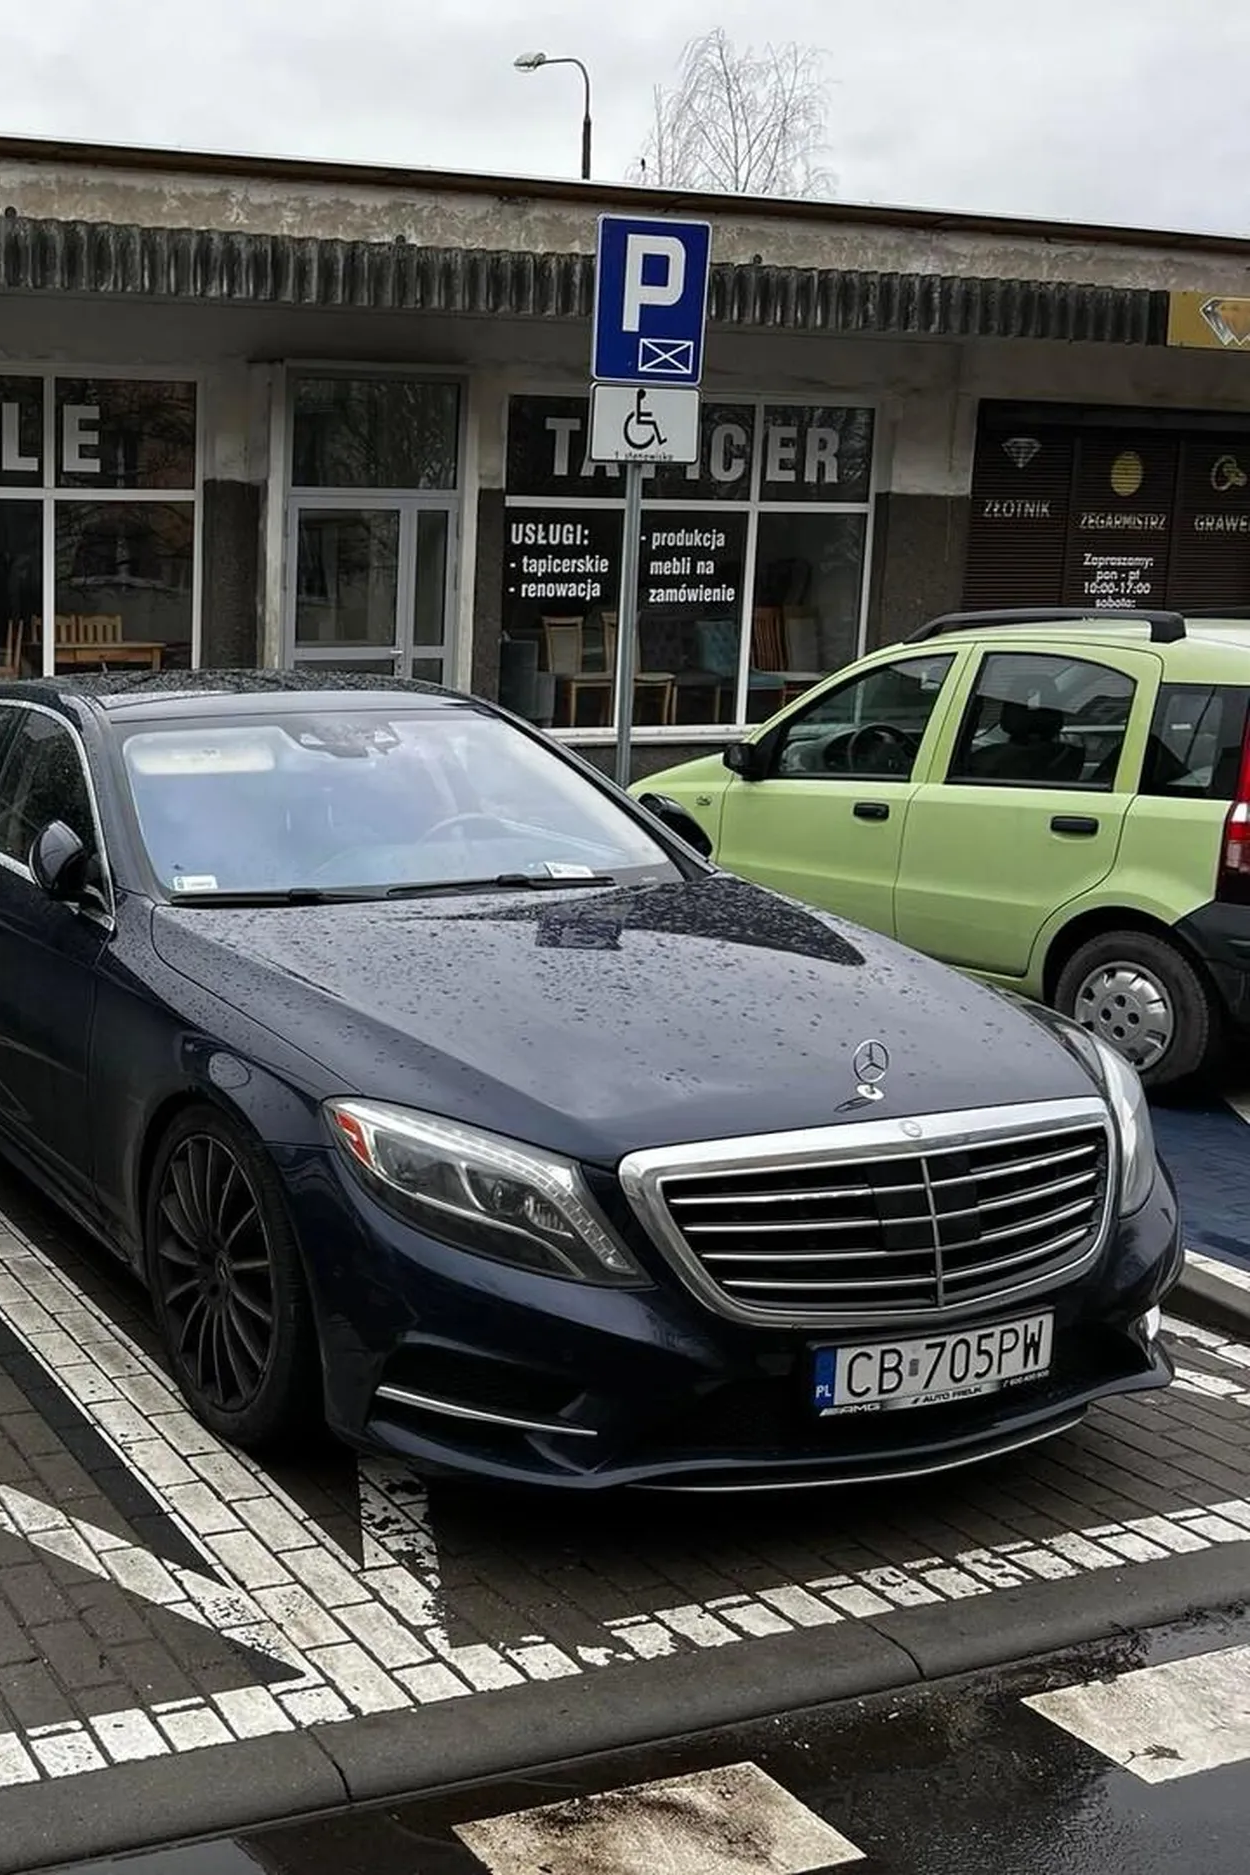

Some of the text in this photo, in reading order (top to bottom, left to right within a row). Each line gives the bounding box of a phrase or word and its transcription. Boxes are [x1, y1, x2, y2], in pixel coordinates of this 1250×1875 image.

[622, 233, 687, 332] P
[545, 417, 839, 485] TCER
[983, 500, 1052, 518] ZŁOTNIK
[1079, 512, 1167, 531] ZEGARMISTRZ
[1194, 514, 1250, 532] GRAWE
[511, 523, 589, 545] USŁUGI:
[652, 528, 725, 551] produkcja
[522, 554, 609, 577] tapicerskie
[650, 557, 715, 575] mebli na
[521, 579, 601, 601] renowacja
[649, 583, 736, 603] zamówienie
[846, 1320, 1044, 1398] CB 705PW
[815, 1384, 832, 1398] PL
